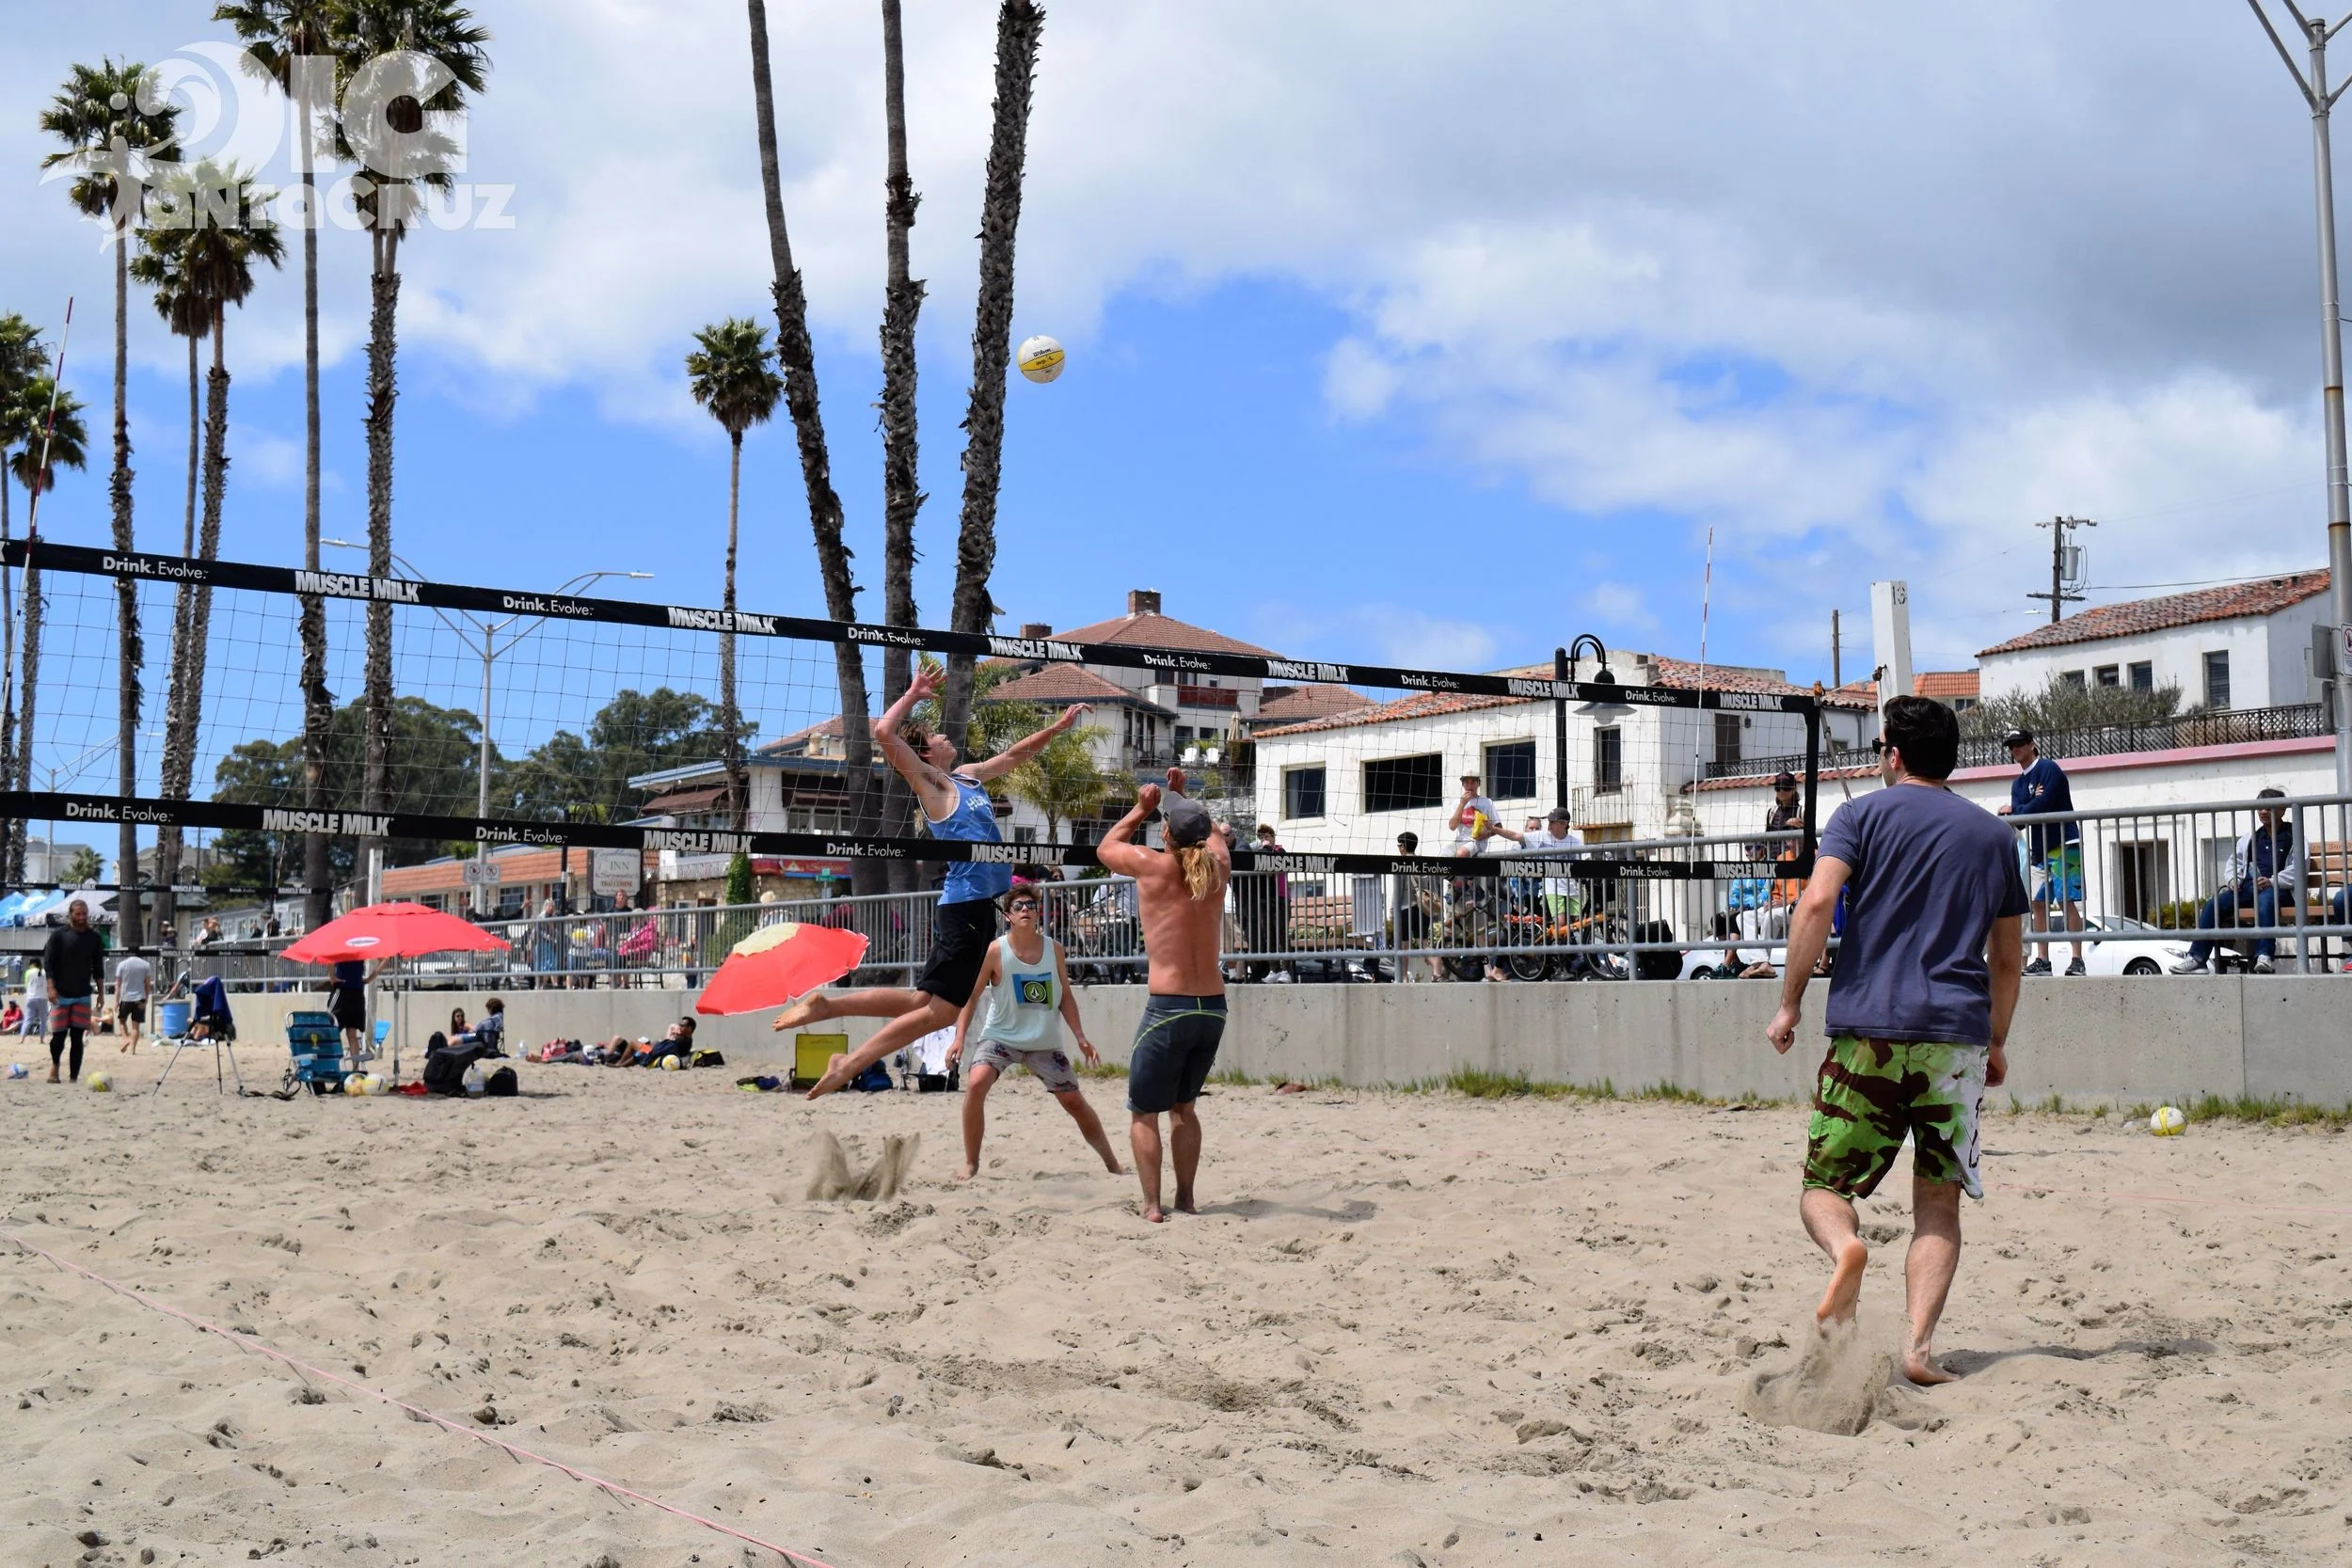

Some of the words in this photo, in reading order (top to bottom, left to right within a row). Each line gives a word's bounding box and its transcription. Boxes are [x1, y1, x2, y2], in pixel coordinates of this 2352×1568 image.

[103, 556, 154, 575] Drink.
[295, 571, 370, 597] MUSCLE
[373, 578, 420, 602] MILK
[503, 596, 548, 612] Drink.
[669, 608, 732, 630] MUSCLE
[736, 613, 776, 634] MILK
[848, 627, 886, 641] Drink.
[989, 638, 1044, 657] MUSCLE
[1047, 642, 1083, 660] MILK
[1267, 660, 1315, 680] MUSCLE
[1317, 664, 1349, 682] MILK
[1508, 678, 1549, 697] MUSCLE
[1550, 683, 1580, 698] MILK
[1720, 692, 1756, 709] MUSCLE
[1758, 696, 1782, 709] MILK
[66, 802, 119, 819] Drink.
[262, 809, 338, 833] MUSCLE
[342, 815, 389, 835] MILK
[475, 827, 521, 842] Drink.
[644, 831, 709, 851] MUSCLE
[712, 833, 753, 853] MILK
[827, 842, 866, 856] Drink.
[971, 844, 1028, 863] MUSCLE
[1030, 847, 1066, 864] MILK
[1255, 854, 1304, 872] MUSCLE
[1305, 856, 1338, 873] MILK
[1500, 862, 1543, 877] MUSCLE
[1544, 862, 1572, 878] MILK
[1714, 863, 1750, 879] MUSCLE
[1752, 863, 1777, 879] MILK
